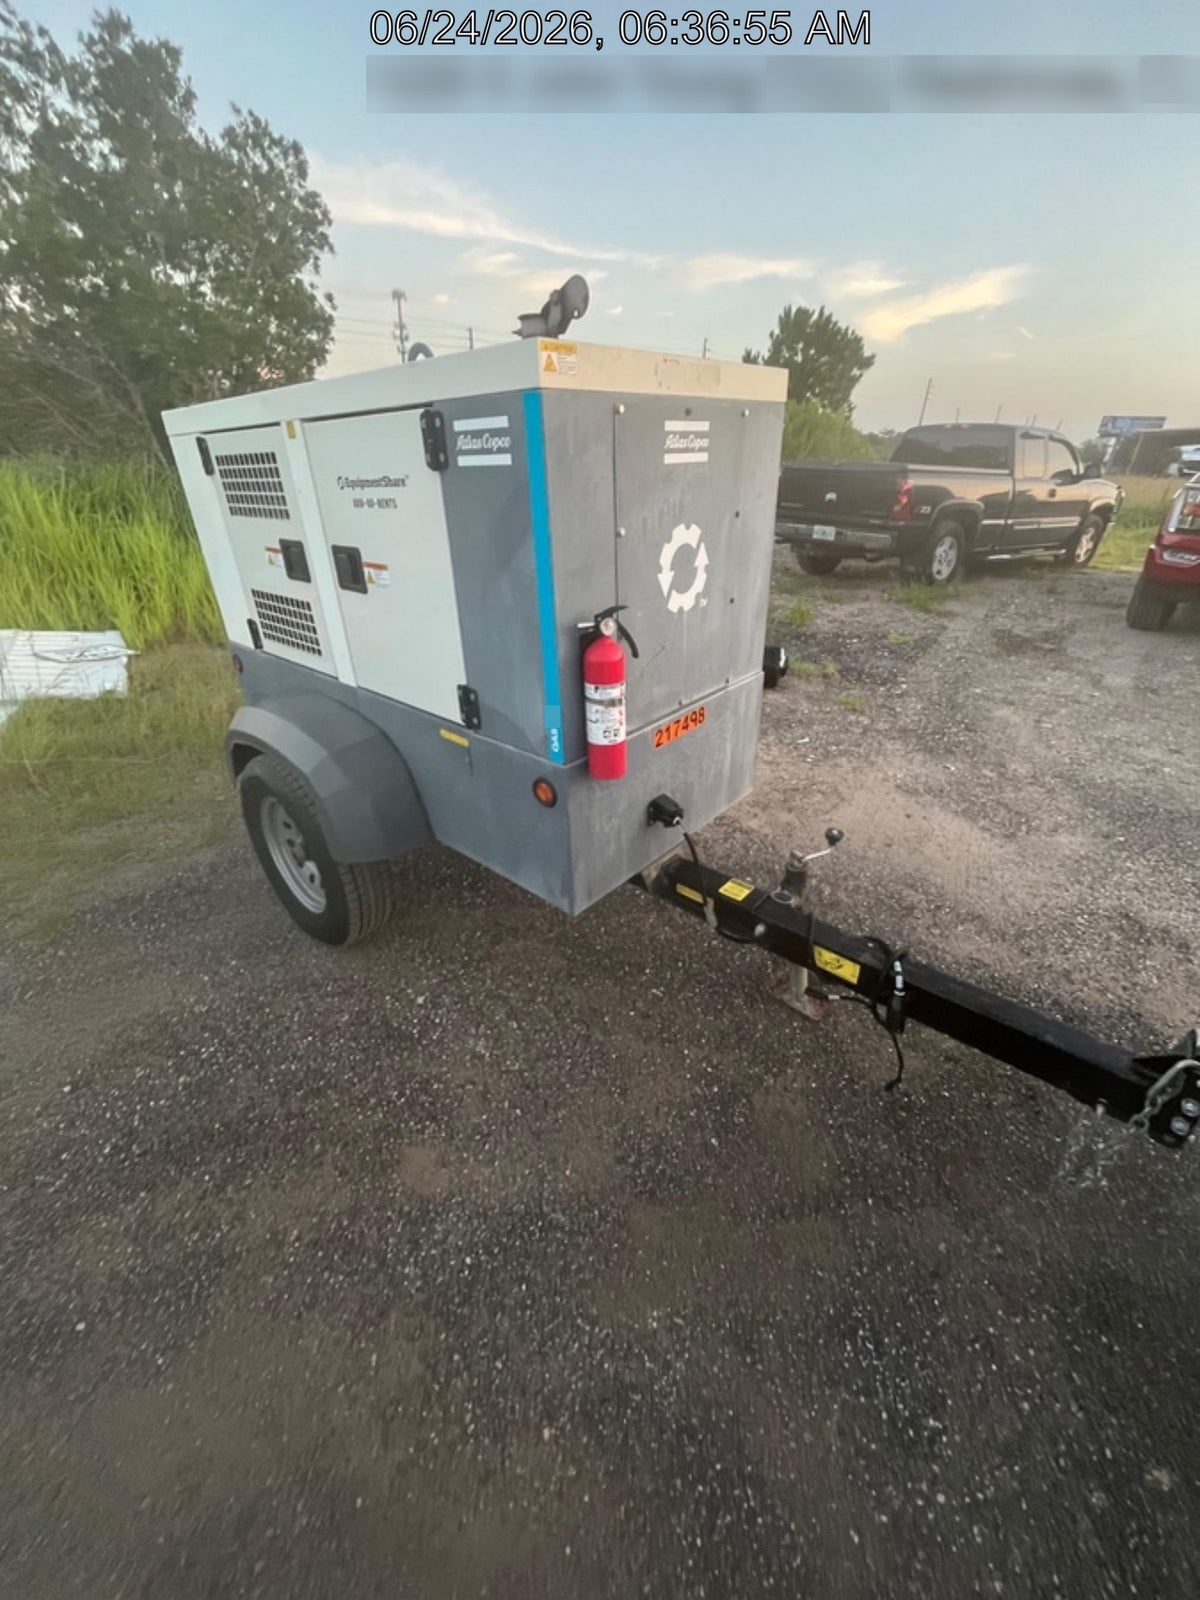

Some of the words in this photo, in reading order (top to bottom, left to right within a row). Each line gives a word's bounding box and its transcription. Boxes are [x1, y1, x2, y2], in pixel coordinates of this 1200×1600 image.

[456, 434, 482, 450] Atlas
[482, 433, 511, 452] Copco
[655, 706, 705, 748] 217498
